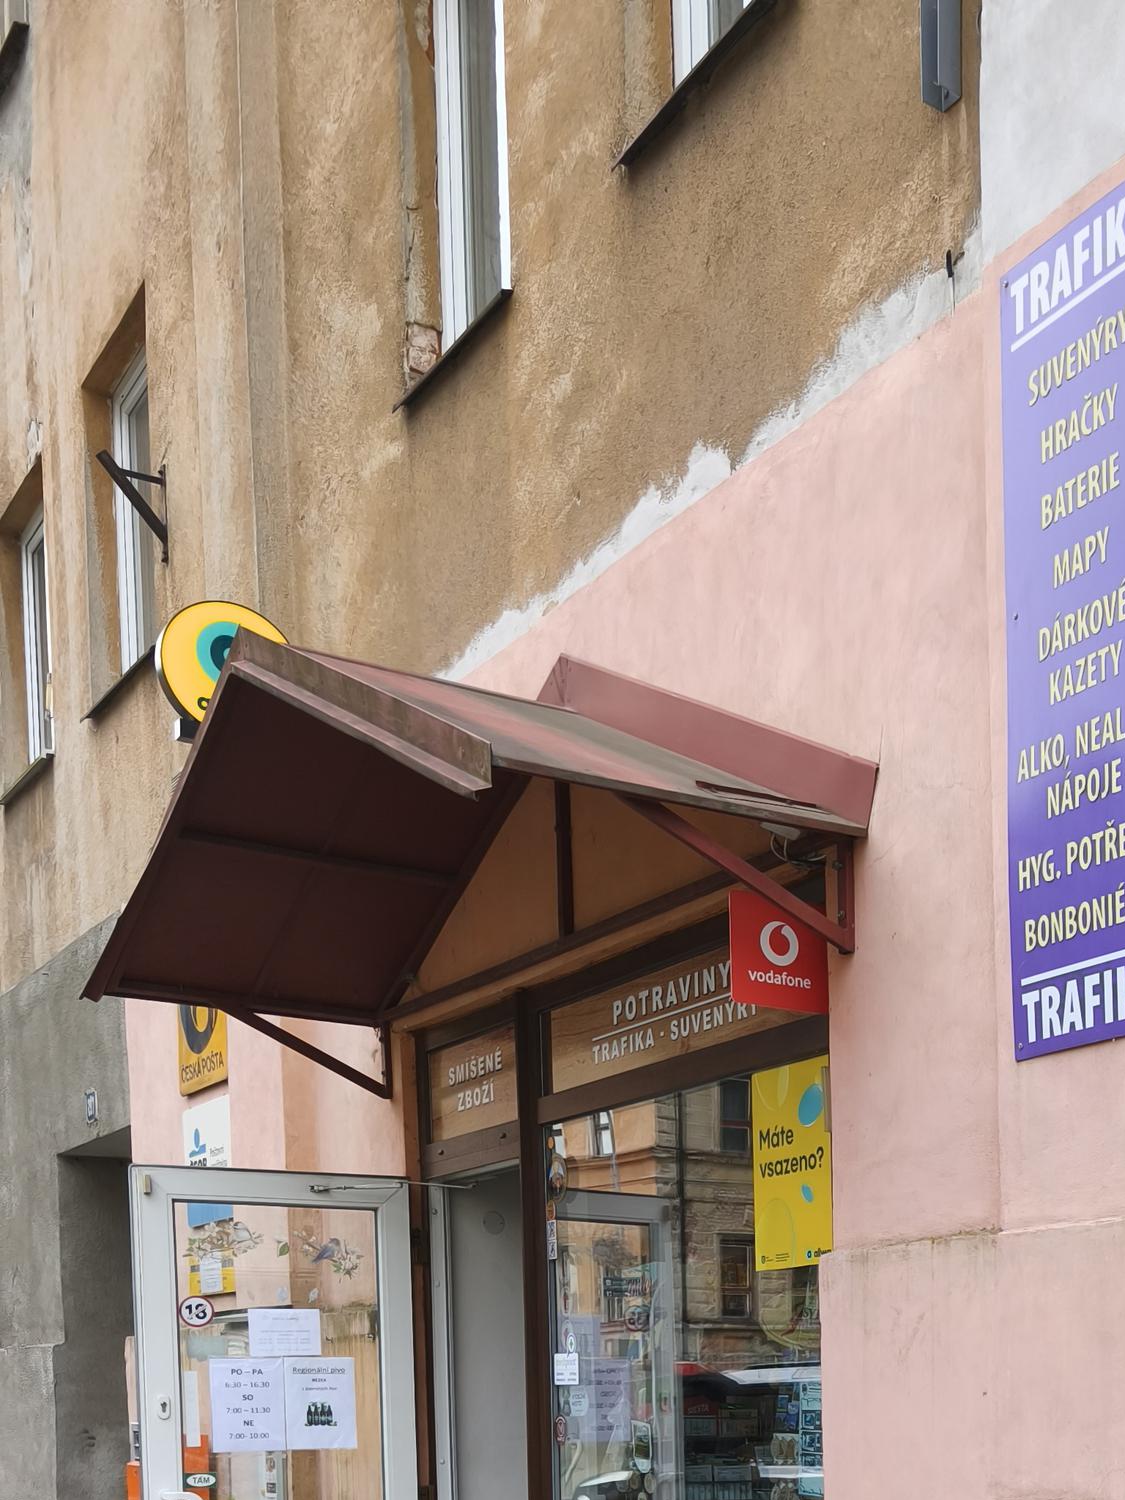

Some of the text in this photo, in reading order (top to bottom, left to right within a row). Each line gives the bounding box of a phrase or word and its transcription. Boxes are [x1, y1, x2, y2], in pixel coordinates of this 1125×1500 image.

[1041, 382, 1119, 464] HRAČKY
[1041, 451, 1120, 531] BATERIE
[1053, 525, 1110, 590] MAPY
[1049, 639, 1123, 707] KAZETY
[1017, 732, 1069, 784] ALKO,
[1046, 758, 1123, 820] NÁPOJE
[1017, 846, 1062, 892] HYG.
[612, 959, 731, 1026] POTRAVINY
[748, 969, 812, 990] vodafone
[592, 1027, 655, 1065] TRAFIKA
[180, 1050, 225, 1084] ČESKÁ POŠTA
[447, 1048, 503, 1088] SMÍŠENÉ
[457, 1079, 496, 1112] ZBOŽÍ
[758, 1124, 795, 1152] Máte
[758, 1145, 825, 1180] vsazeno?
[184, 1302, 207, 1321] 18
[230, 1368, 243, 1376] PO
[252, 1368, 264, 1376] PA
[331, 1367, 346, 1376] pivo
[242, 1394, 254, 1402] SO
